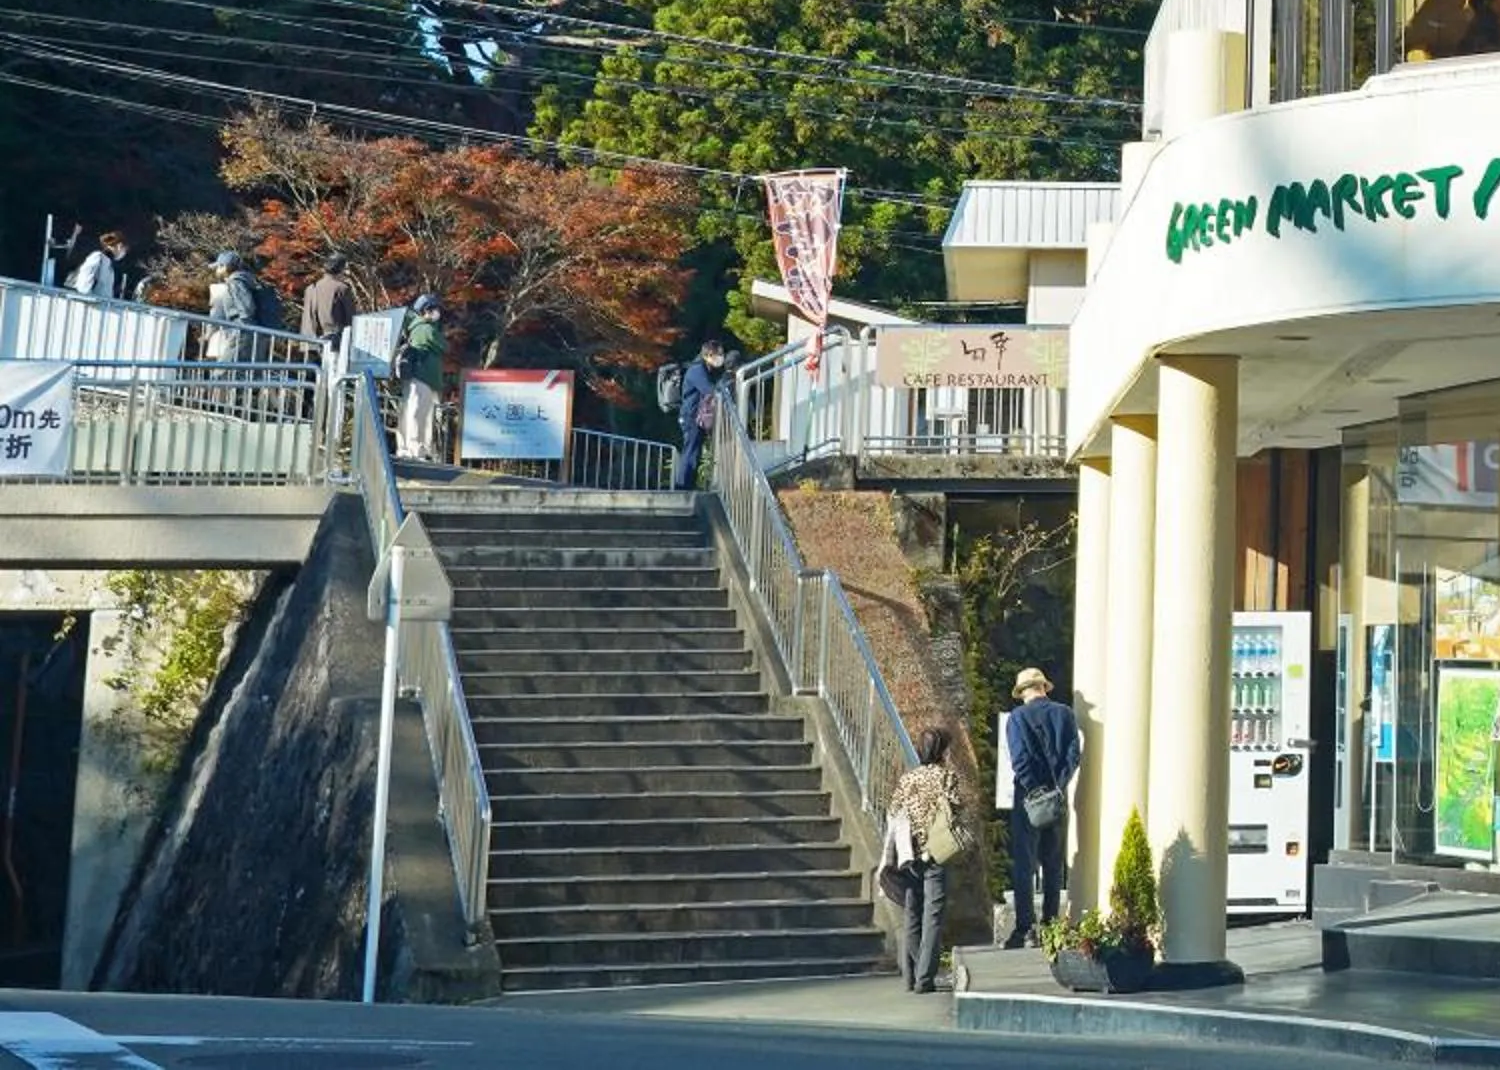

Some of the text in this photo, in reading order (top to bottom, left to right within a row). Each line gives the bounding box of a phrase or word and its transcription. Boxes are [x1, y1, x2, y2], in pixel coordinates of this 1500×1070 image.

[1166, 195, 1258, 264] GREEN
[1266, 165, 1465, 238] MARKET
[903, 373, 1049, 388] CAFE RESTAURANT
